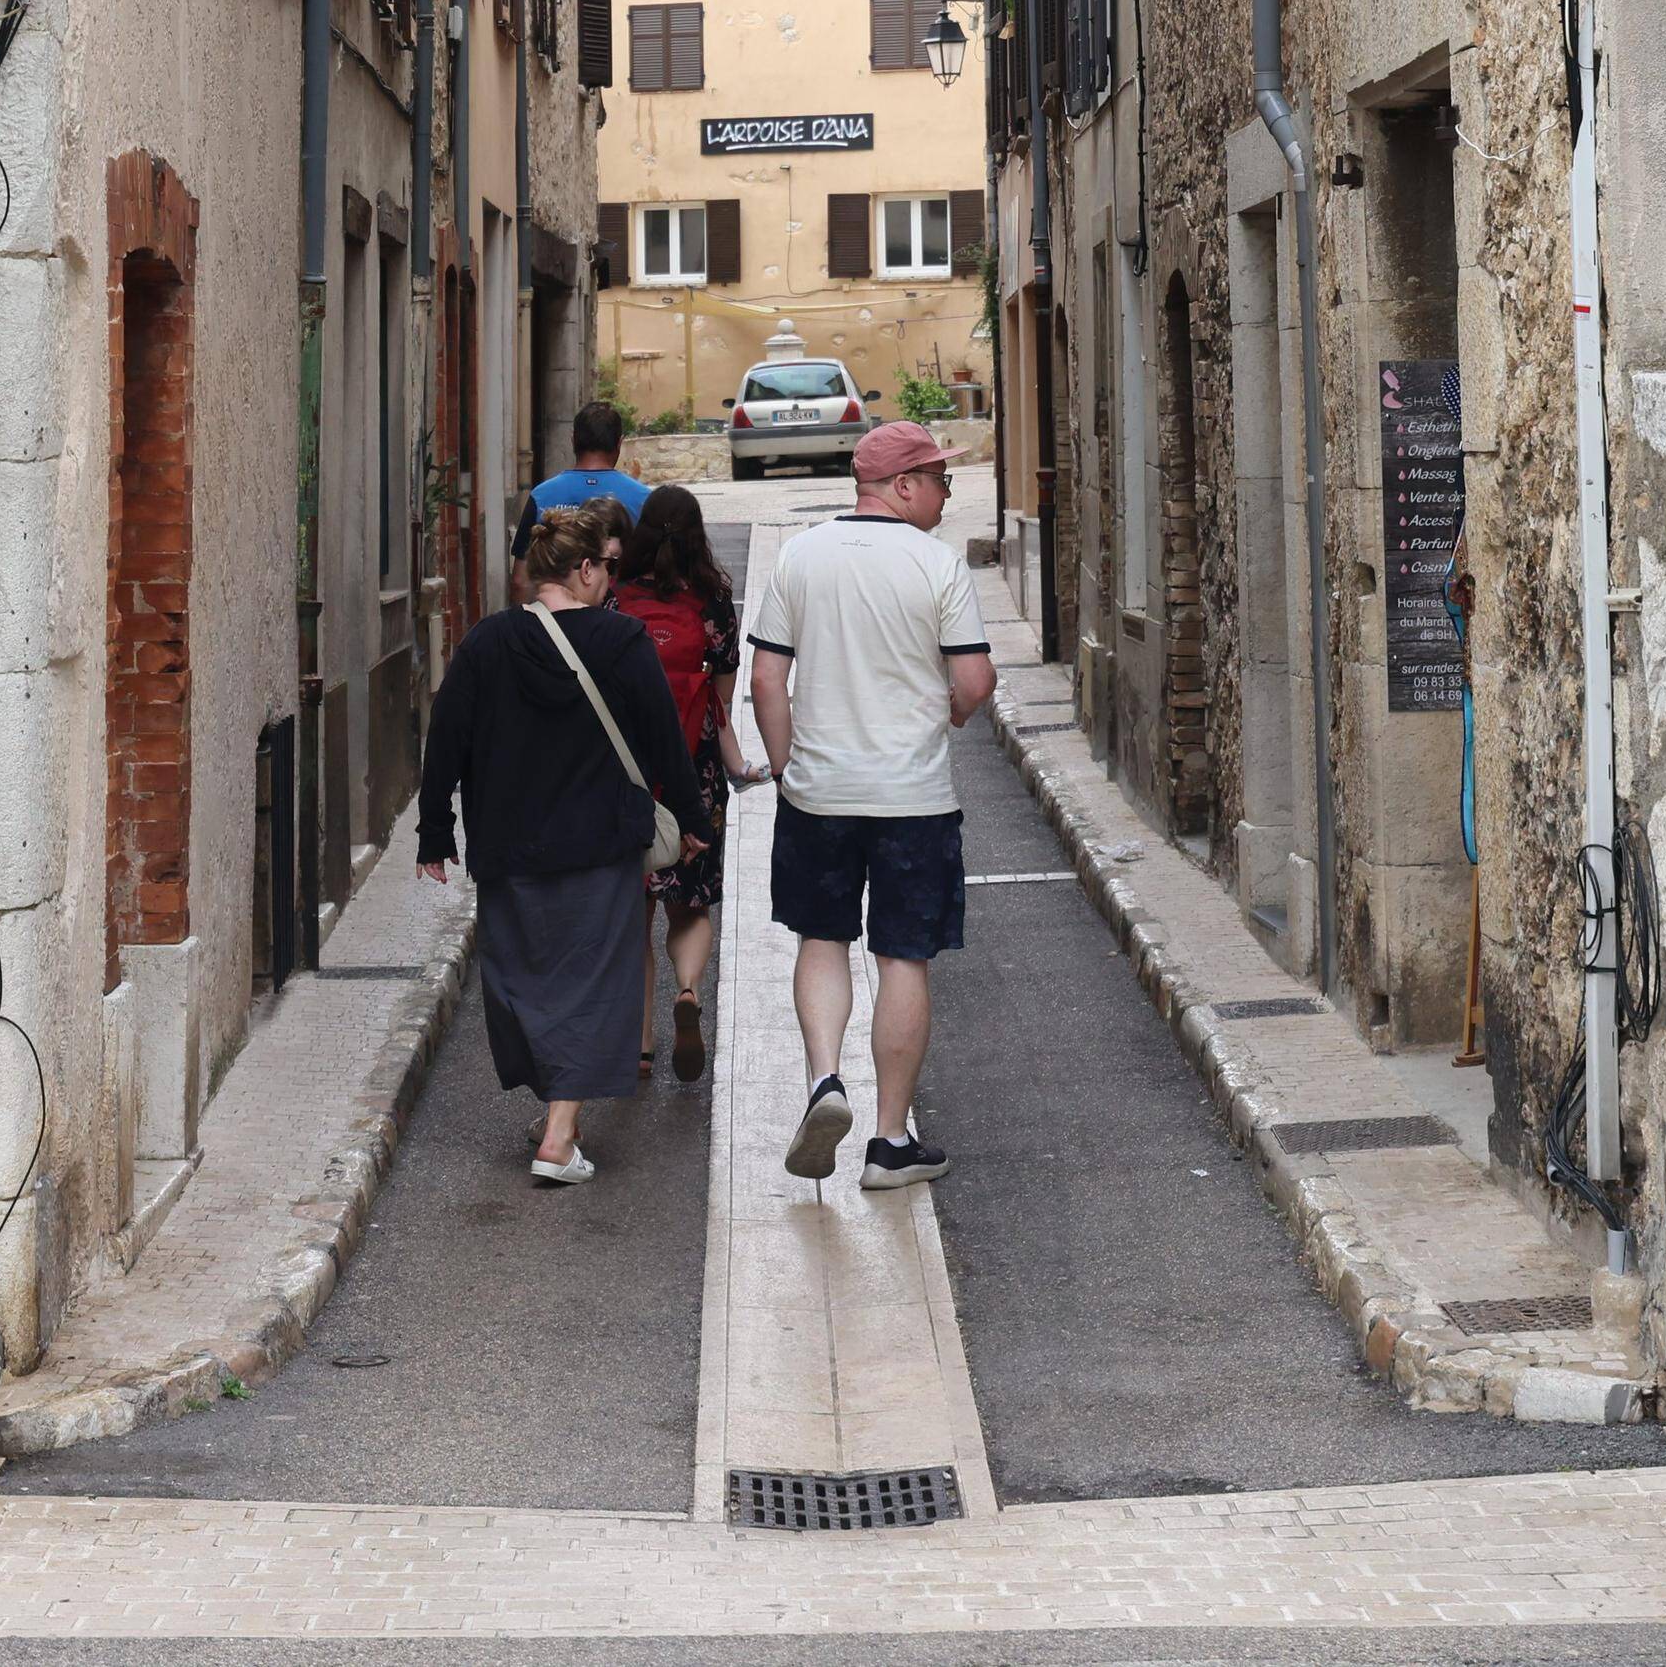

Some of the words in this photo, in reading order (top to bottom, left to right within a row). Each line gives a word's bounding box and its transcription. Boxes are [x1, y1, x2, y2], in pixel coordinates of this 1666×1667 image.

[707, 119, 804, 145] L'ARDOISE
[812, 117, 869, 141] D'ANA
[1408, 444, 1460, 461] Onglerie
[1410, 491, 1444, 503] Vente
[1397, 597, 1444, 608] Horaires
[1399, 617, 1413, 628] du
[1416, 616, 1447, 628] Mardi
[1420, 629, 1433, 640] de
[1436, 629, 1452, 640] 9H
[1401, 664, 1420, 674] sur
[1414, 677, 1428, 687] 09
[1431, 676, 1445, 687] 83
[1448, 676, 1462, 687] 33
[1414, 690, 1428, 701] 06
[1432, 690, 1445, 701] 14
